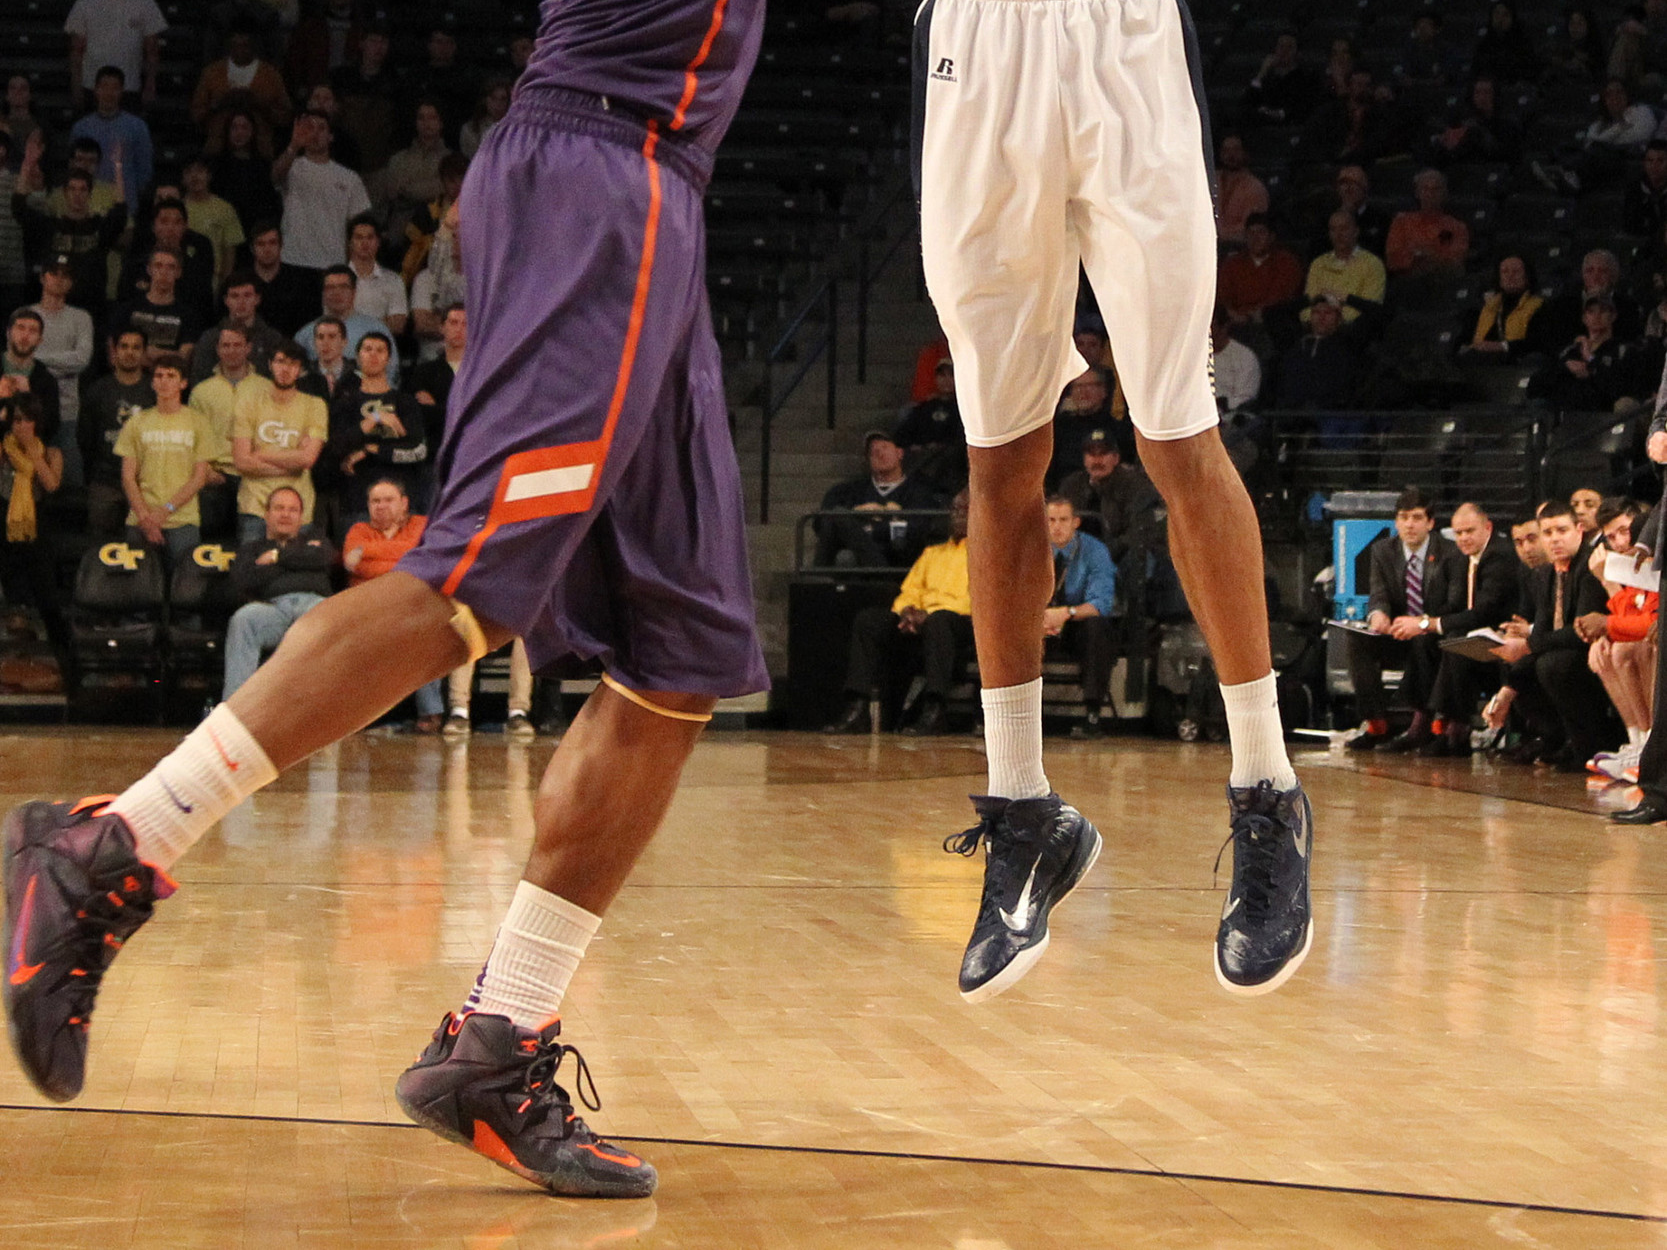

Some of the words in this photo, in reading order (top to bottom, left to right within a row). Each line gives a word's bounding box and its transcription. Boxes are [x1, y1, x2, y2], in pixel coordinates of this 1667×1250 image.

[258, 420, 300, 448] GT
[98, 542, 146, 570] GT
[192, 543, 237, 572] GT
